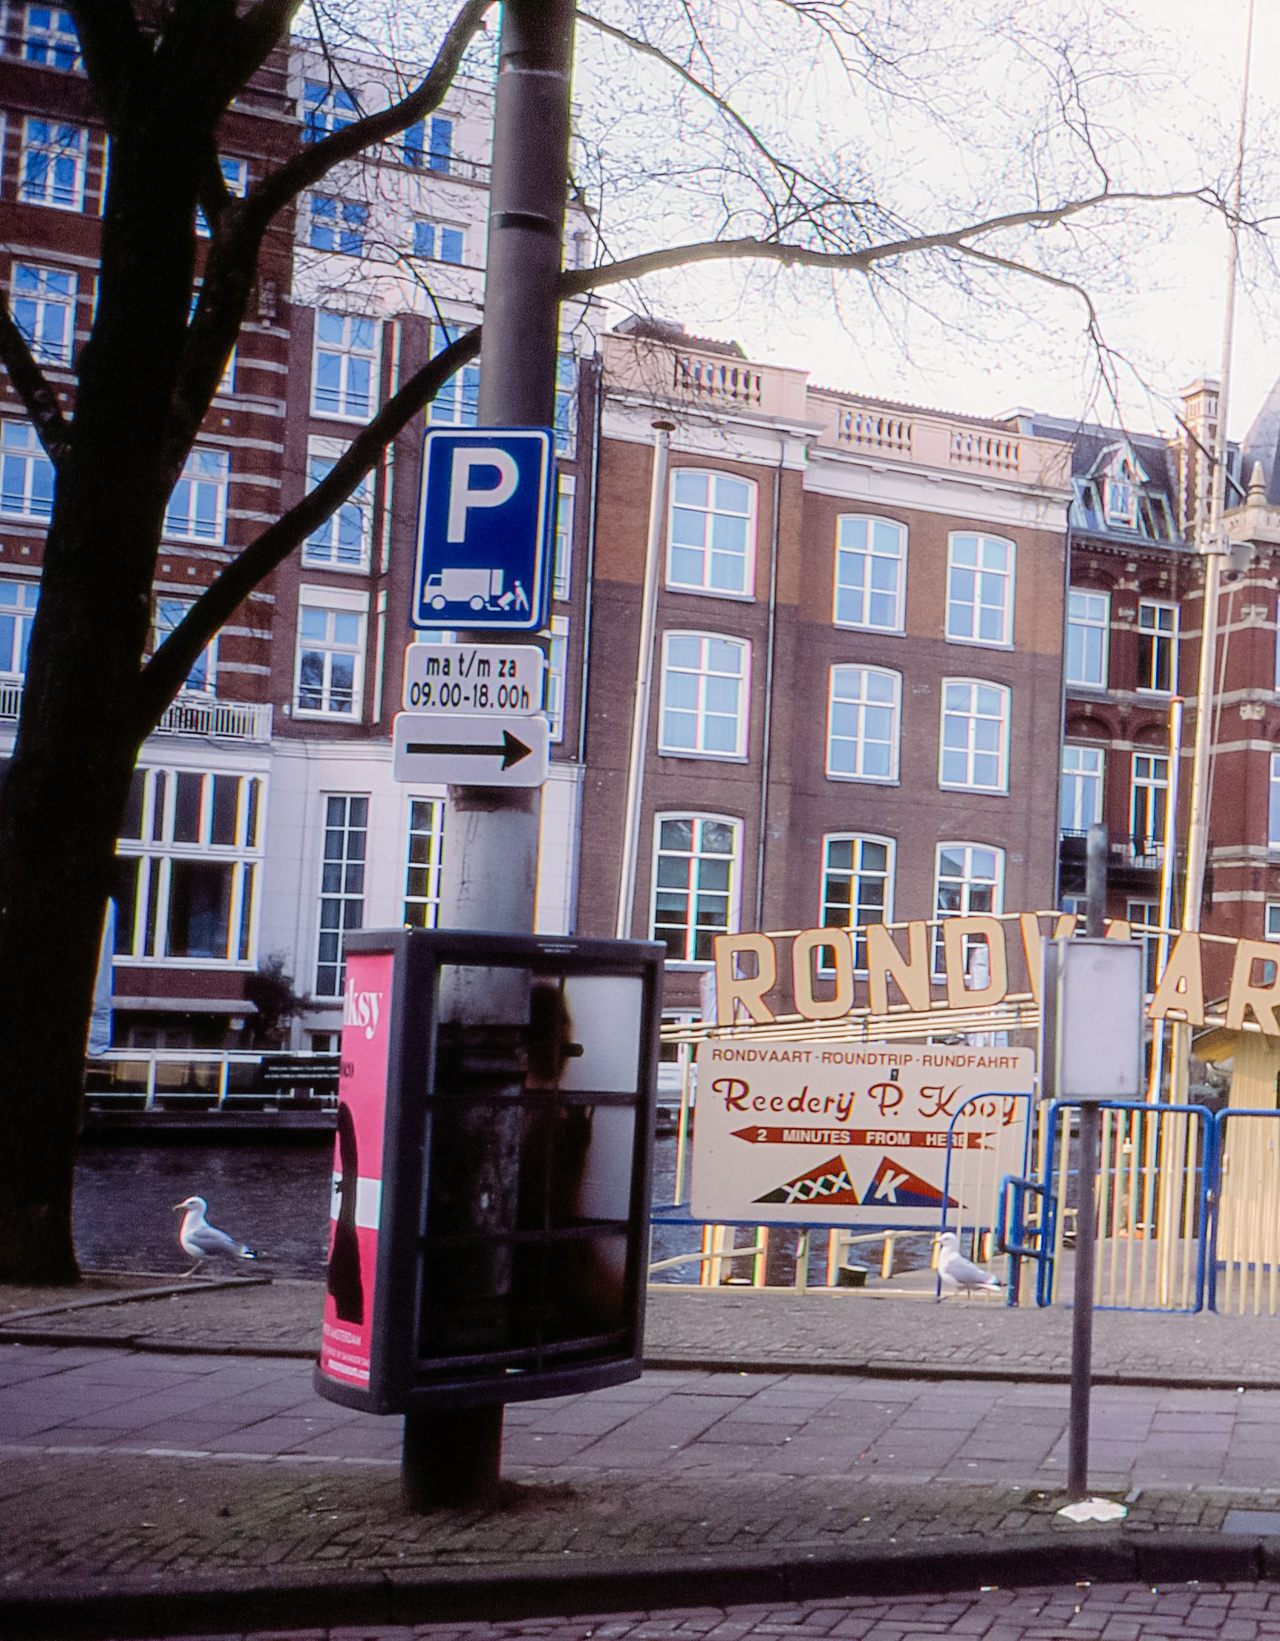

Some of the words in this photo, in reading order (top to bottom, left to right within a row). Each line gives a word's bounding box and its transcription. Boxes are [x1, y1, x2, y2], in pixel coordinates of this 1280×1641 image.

[447, 447, 519, 543] P
[426, 656, 450, 677] ma
[458, 651, 490, 679] t/m
[498, 657, 517, 678] za
[410, 682, 529, 709] 09.00-18.00h
[868, 1083, 904, 1117] P.
[757, 1129, 767, 1141] 2
[783, 1129, 850, 1143] MINUTES
[866, 1131, 910, 1145] FROM
